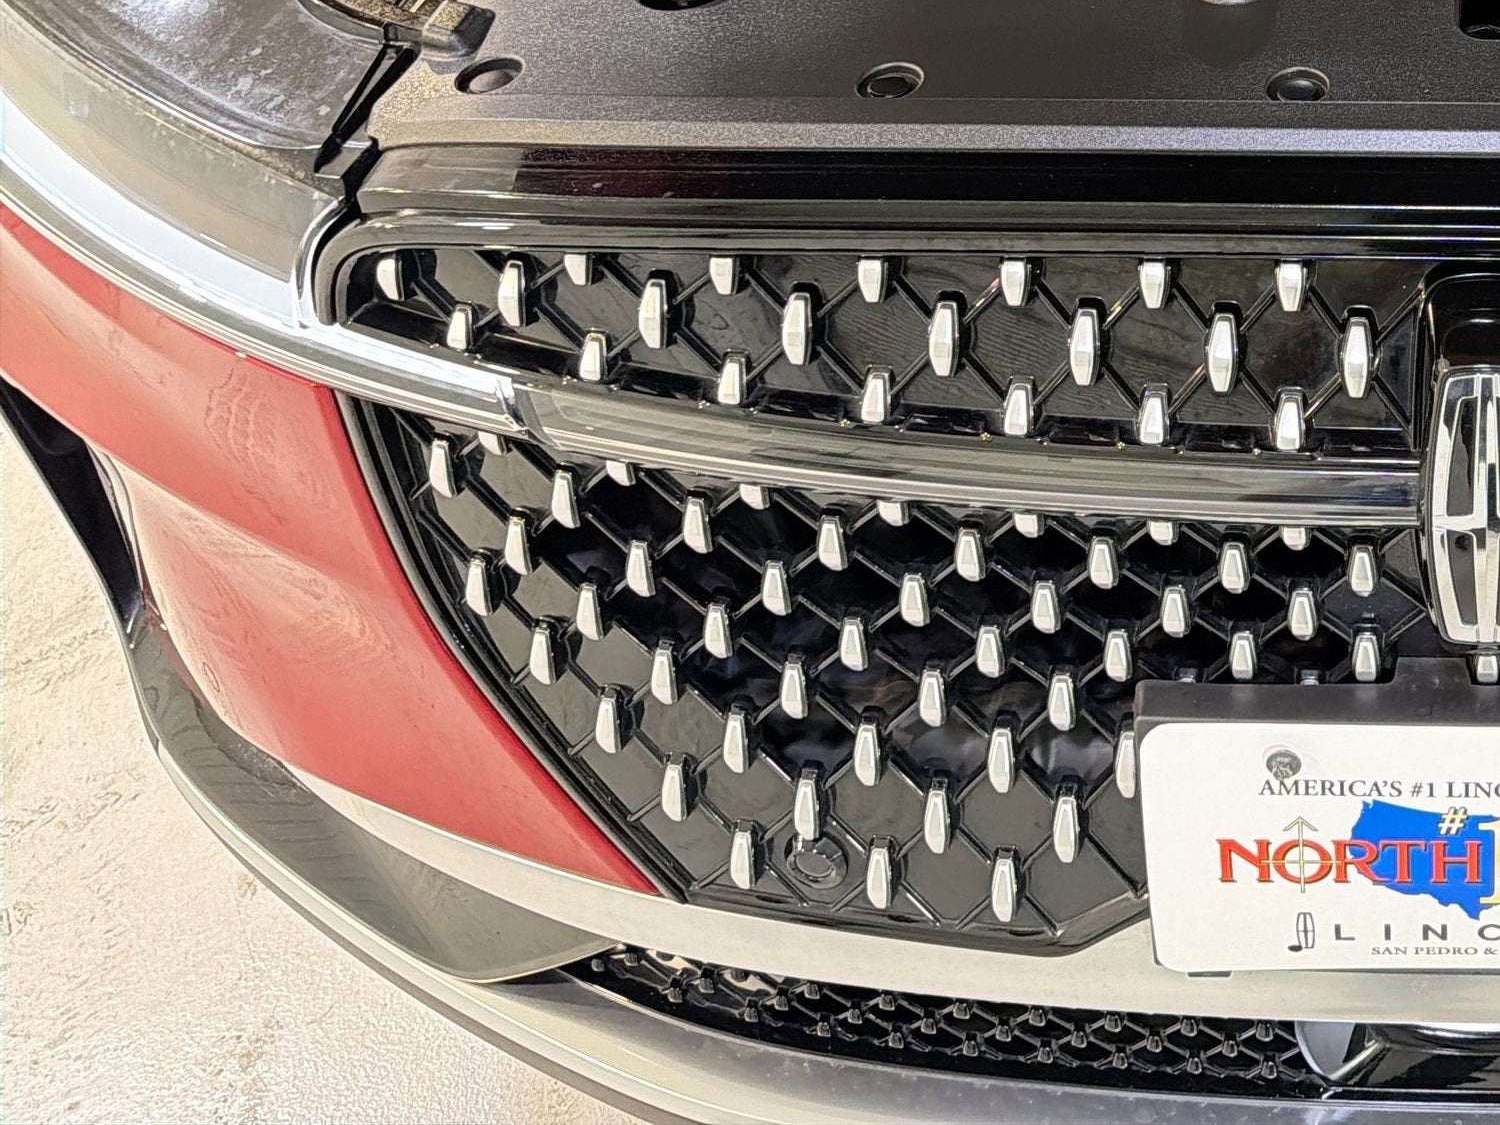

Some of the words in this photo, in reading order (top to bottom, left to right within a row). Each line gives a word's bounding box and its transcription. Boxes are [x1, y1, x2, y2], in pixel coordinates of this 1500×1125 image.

[1258, 779, 1403, 798] AMERICA'S
[1409, 781, 1438, 798] #1
[1216, 838, 1483, 884] NORTH
[1371, 946, 1408, 956] SAN
[1414, 946, 1478, 956] PEDRO
[1483, 947, 1498, 956] &
